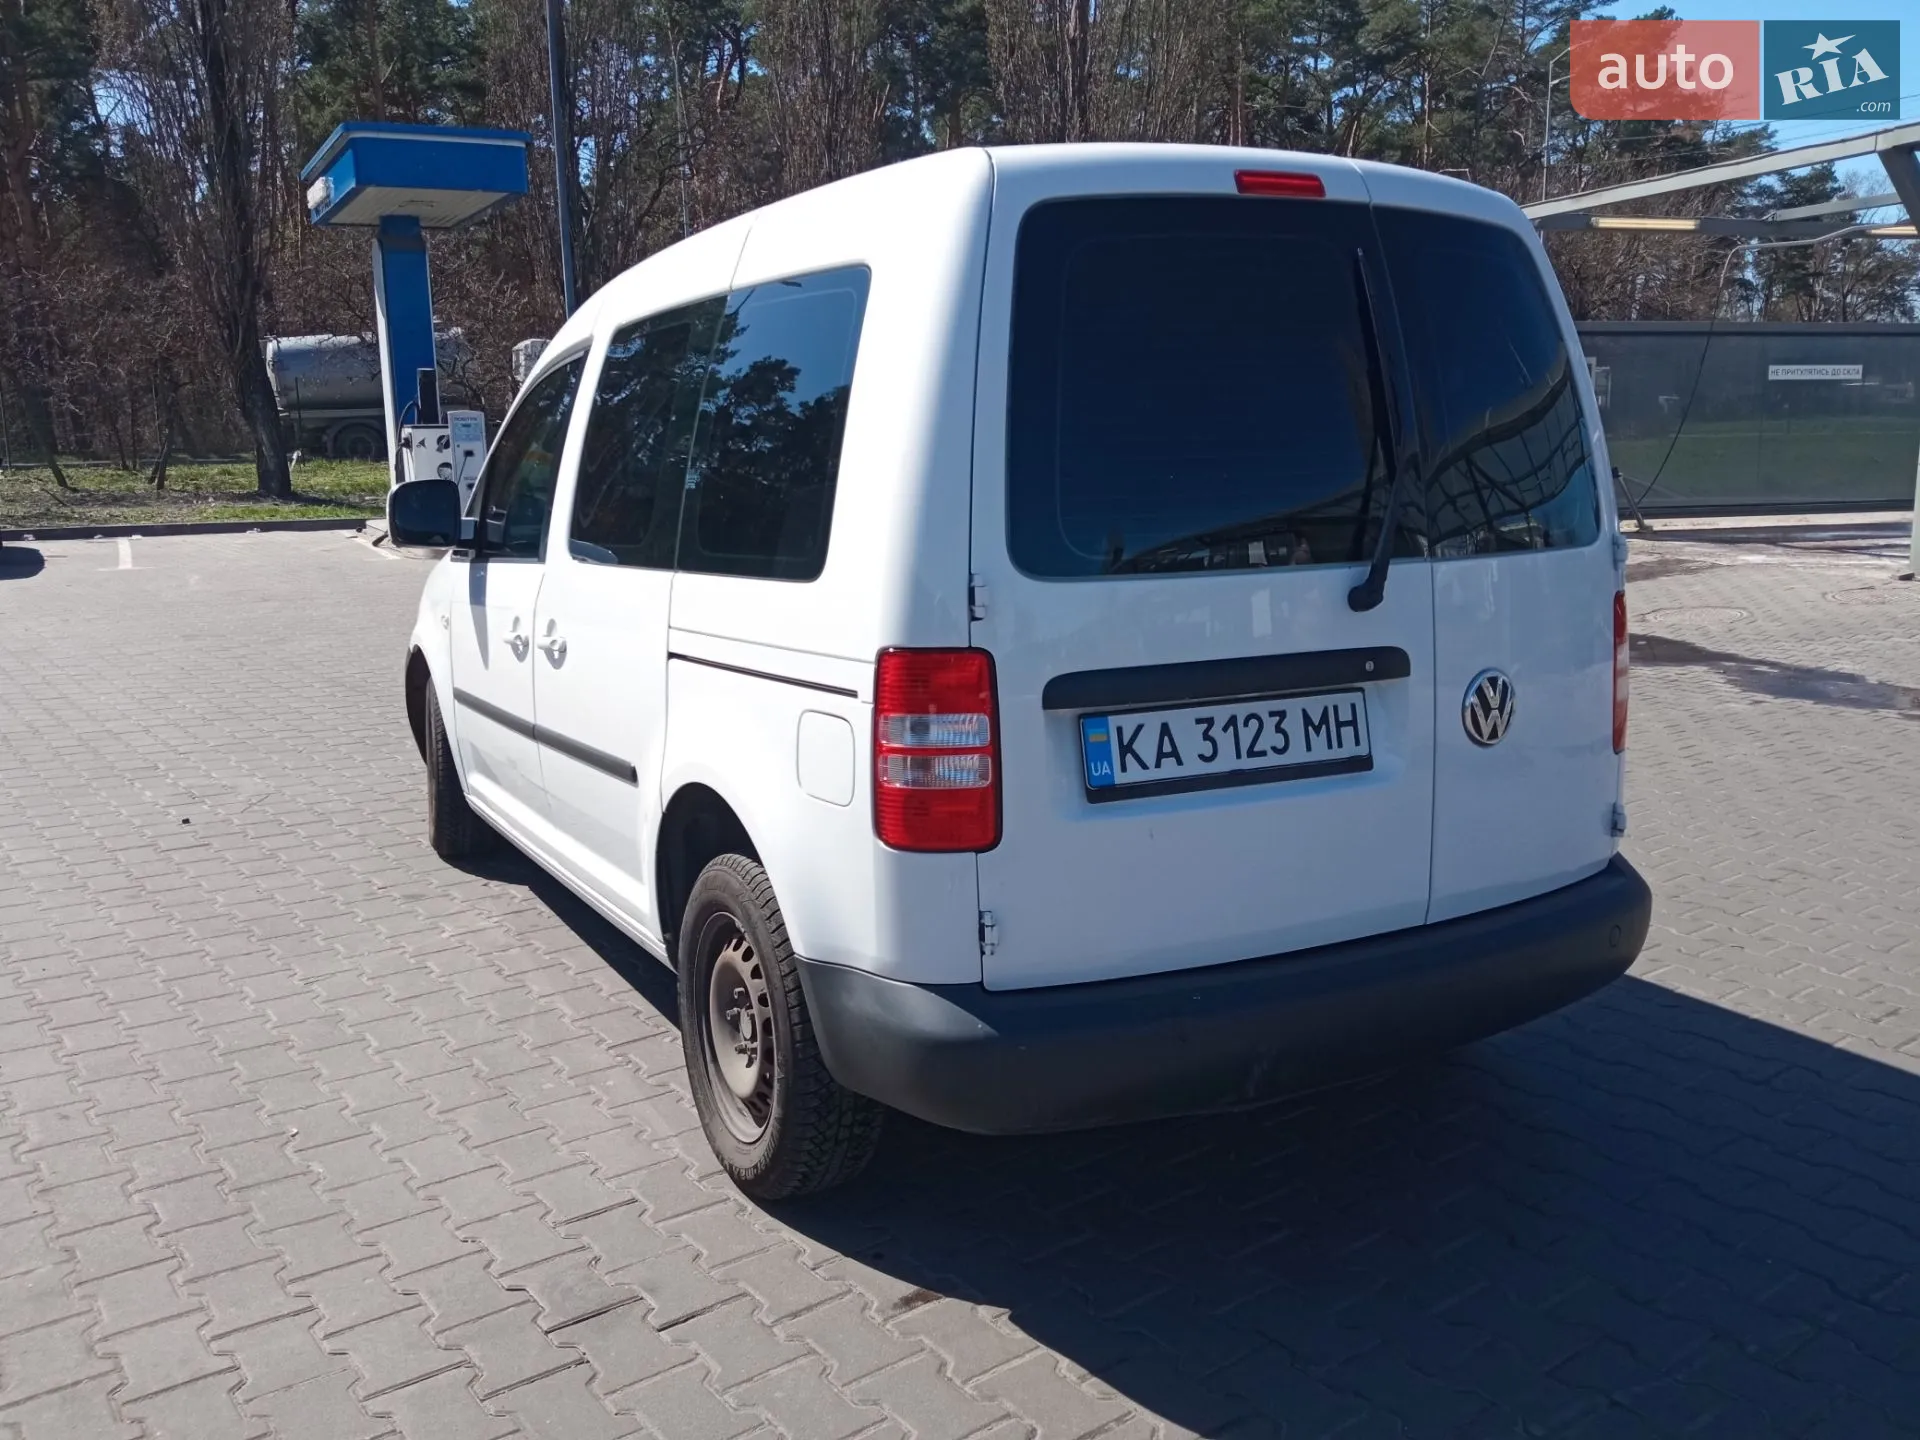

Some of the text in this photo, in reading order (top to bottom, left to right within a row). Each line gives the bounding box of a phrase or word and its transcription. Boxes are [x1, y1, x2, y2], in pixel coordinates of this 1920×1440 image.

[1116, 702, 1361, 773] KA 3123 MH
[1090, 760, 1111, 776] UA
